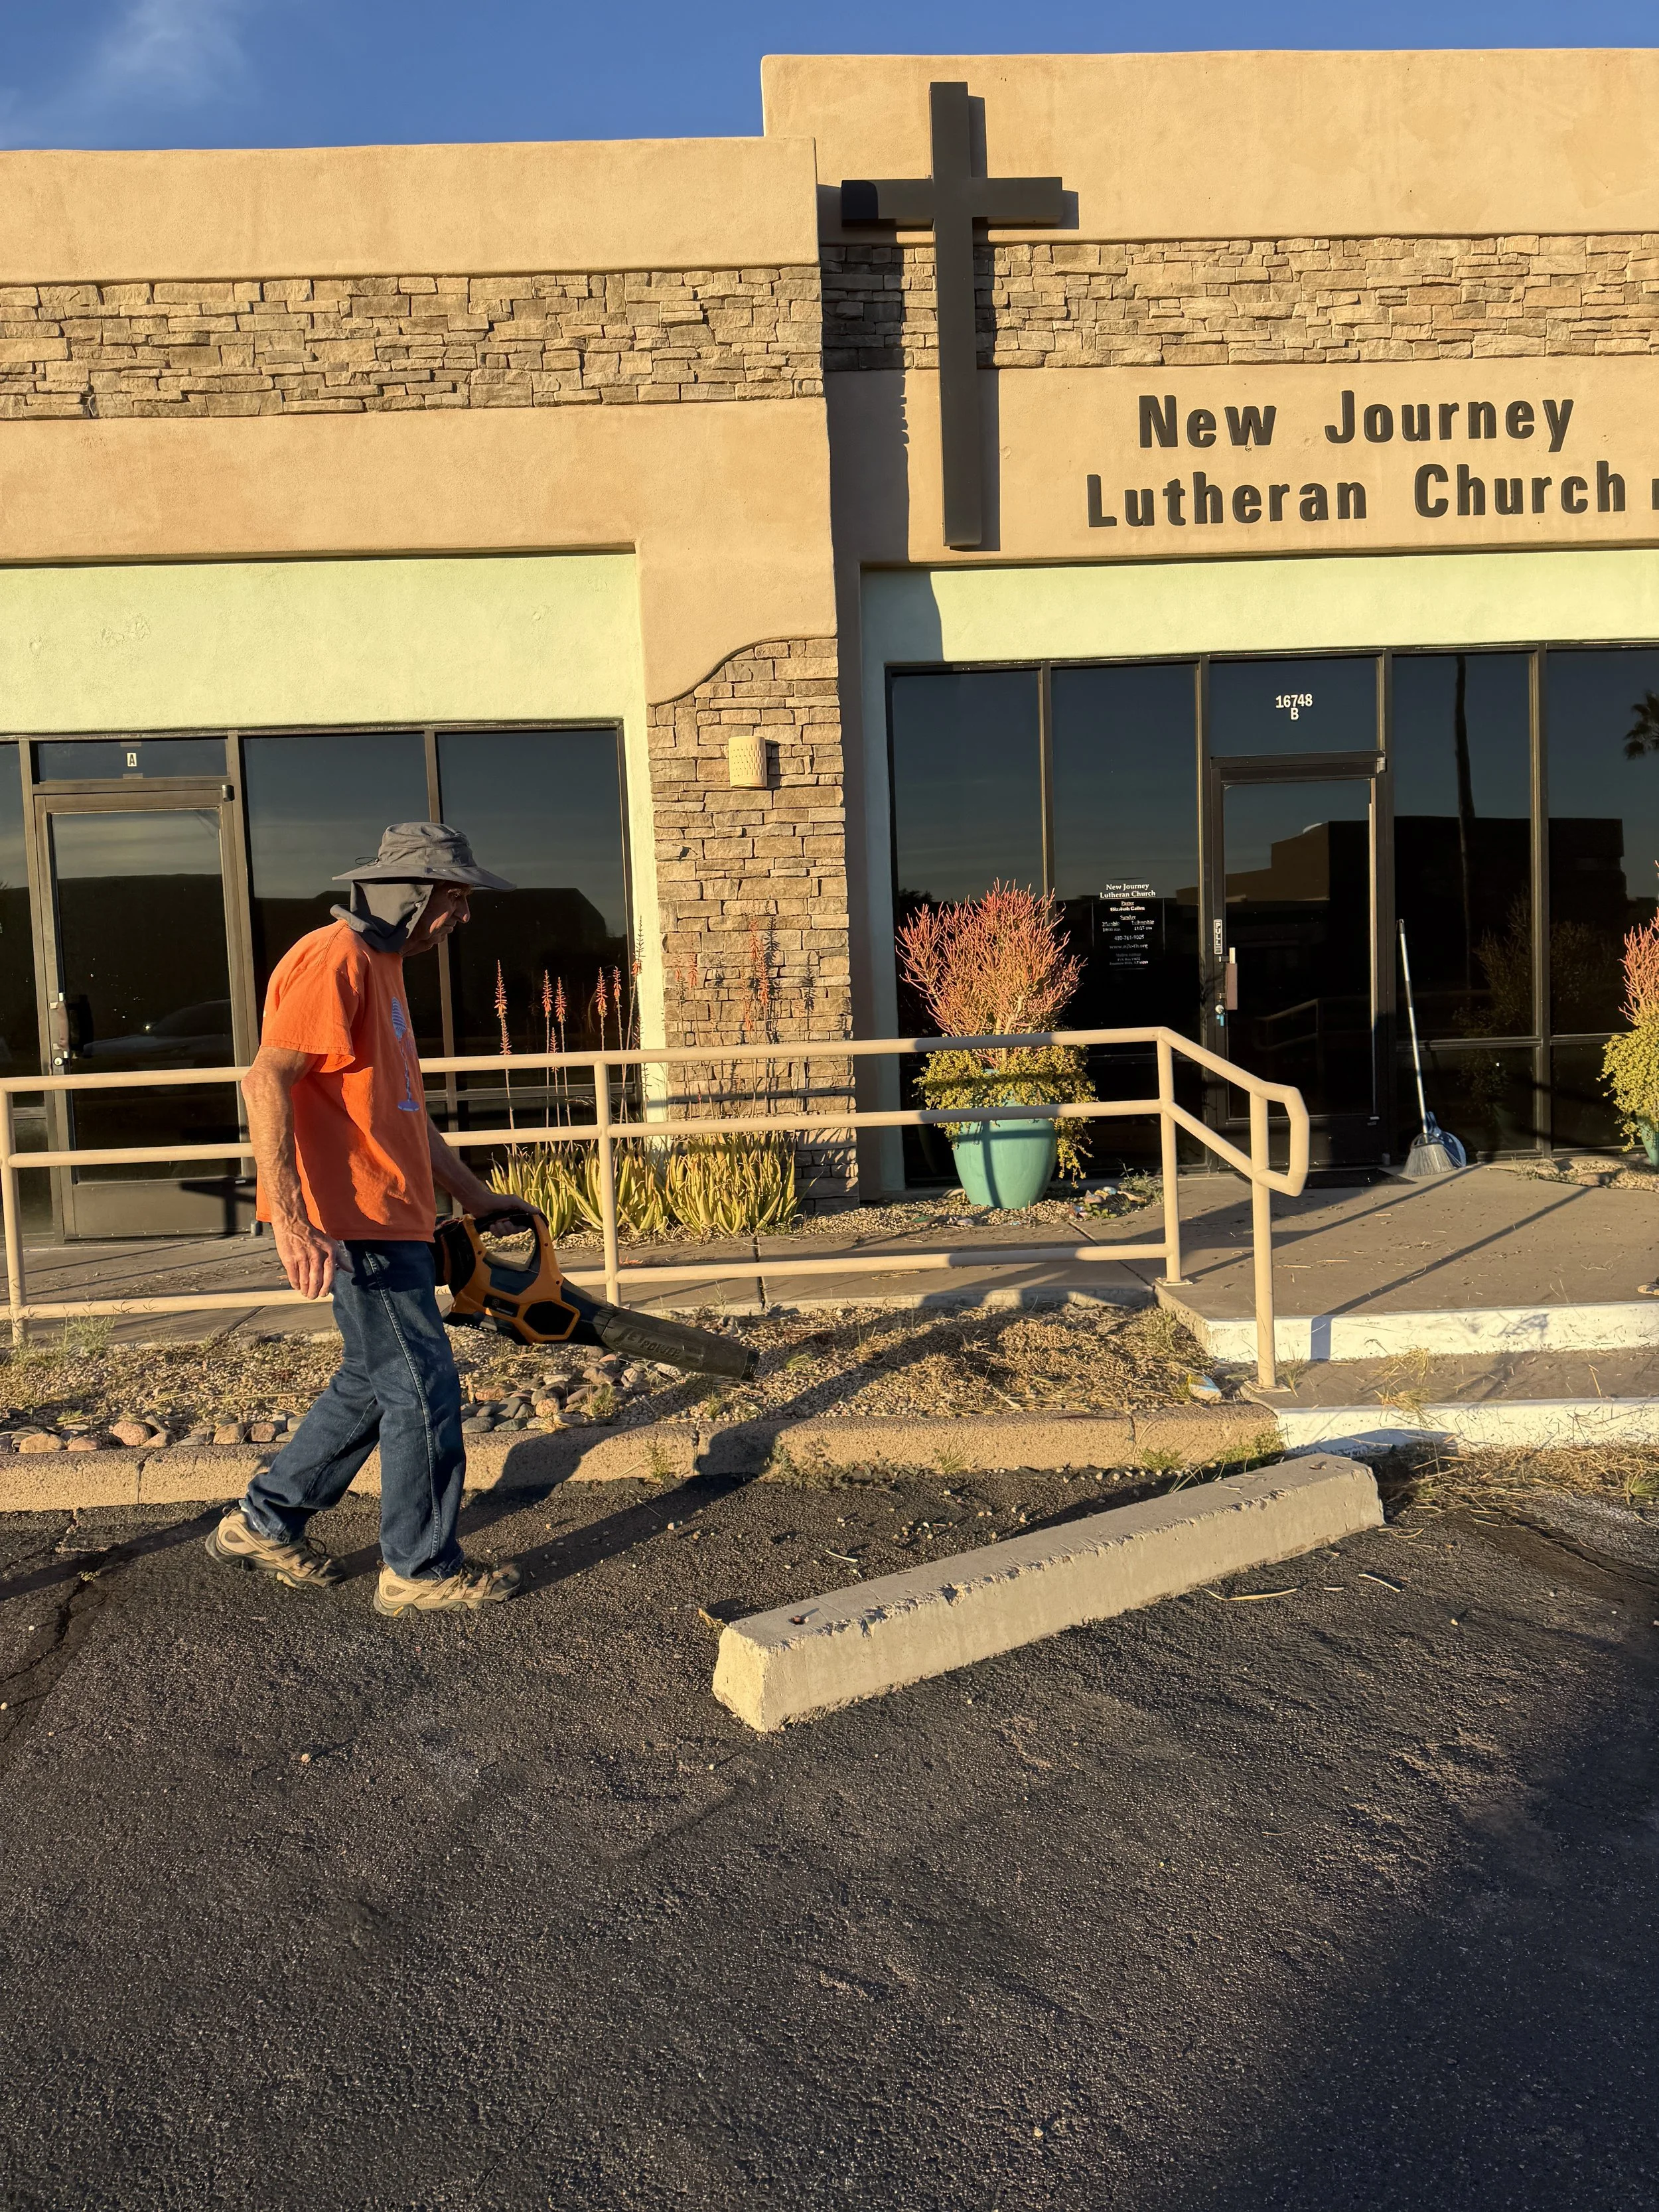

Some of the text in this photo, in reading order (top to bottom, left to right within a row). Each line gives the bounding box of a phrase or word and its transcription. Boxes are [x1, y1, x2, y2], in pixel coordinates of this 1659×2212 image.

[1138, 390, 1574, 452] New Journey
[1086, 471, 1367, 528] Lutheran
[1414, 461, 1626, 516] Church
[1275, 694, 1313, 708] 16748
[1290, 707, 1299, 720] B
[129, 754, 135, 765] A
